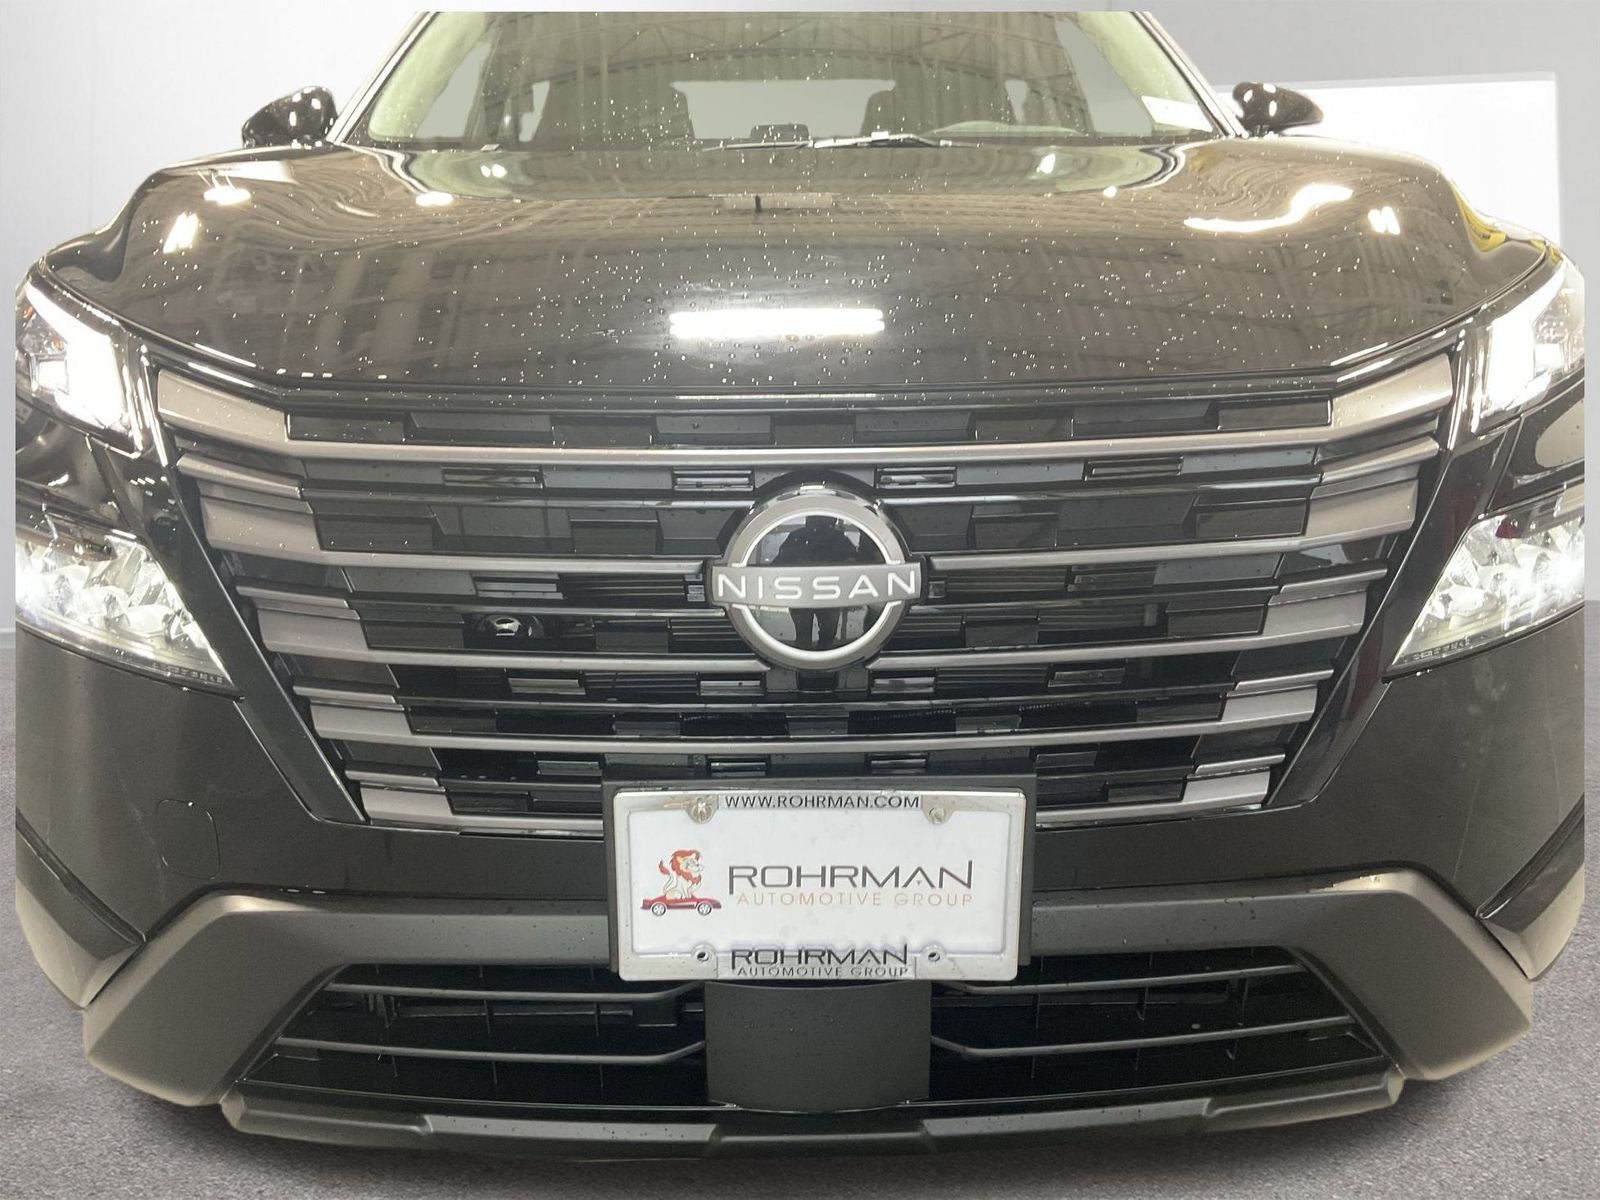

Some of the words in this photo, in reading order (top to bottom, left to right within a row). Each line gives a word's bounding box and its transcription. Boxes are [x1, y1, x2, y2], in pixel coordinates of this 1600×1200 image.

[718, 570, 915, 599] NISSAN
[725, 795, 919, 809] WWW.ROHRMAN.COM
[729, 860, 973, 895] ROHRMAN
[737, 892, 882, 906] AUTOMOTIVE
[894, 892, 973, 906] GROUP
[731, 944, 907, 970] ROHRMAN
[737, 966, 842, 977] AUTOMOTIVE
[851, 966, 908, 977] GROUP
